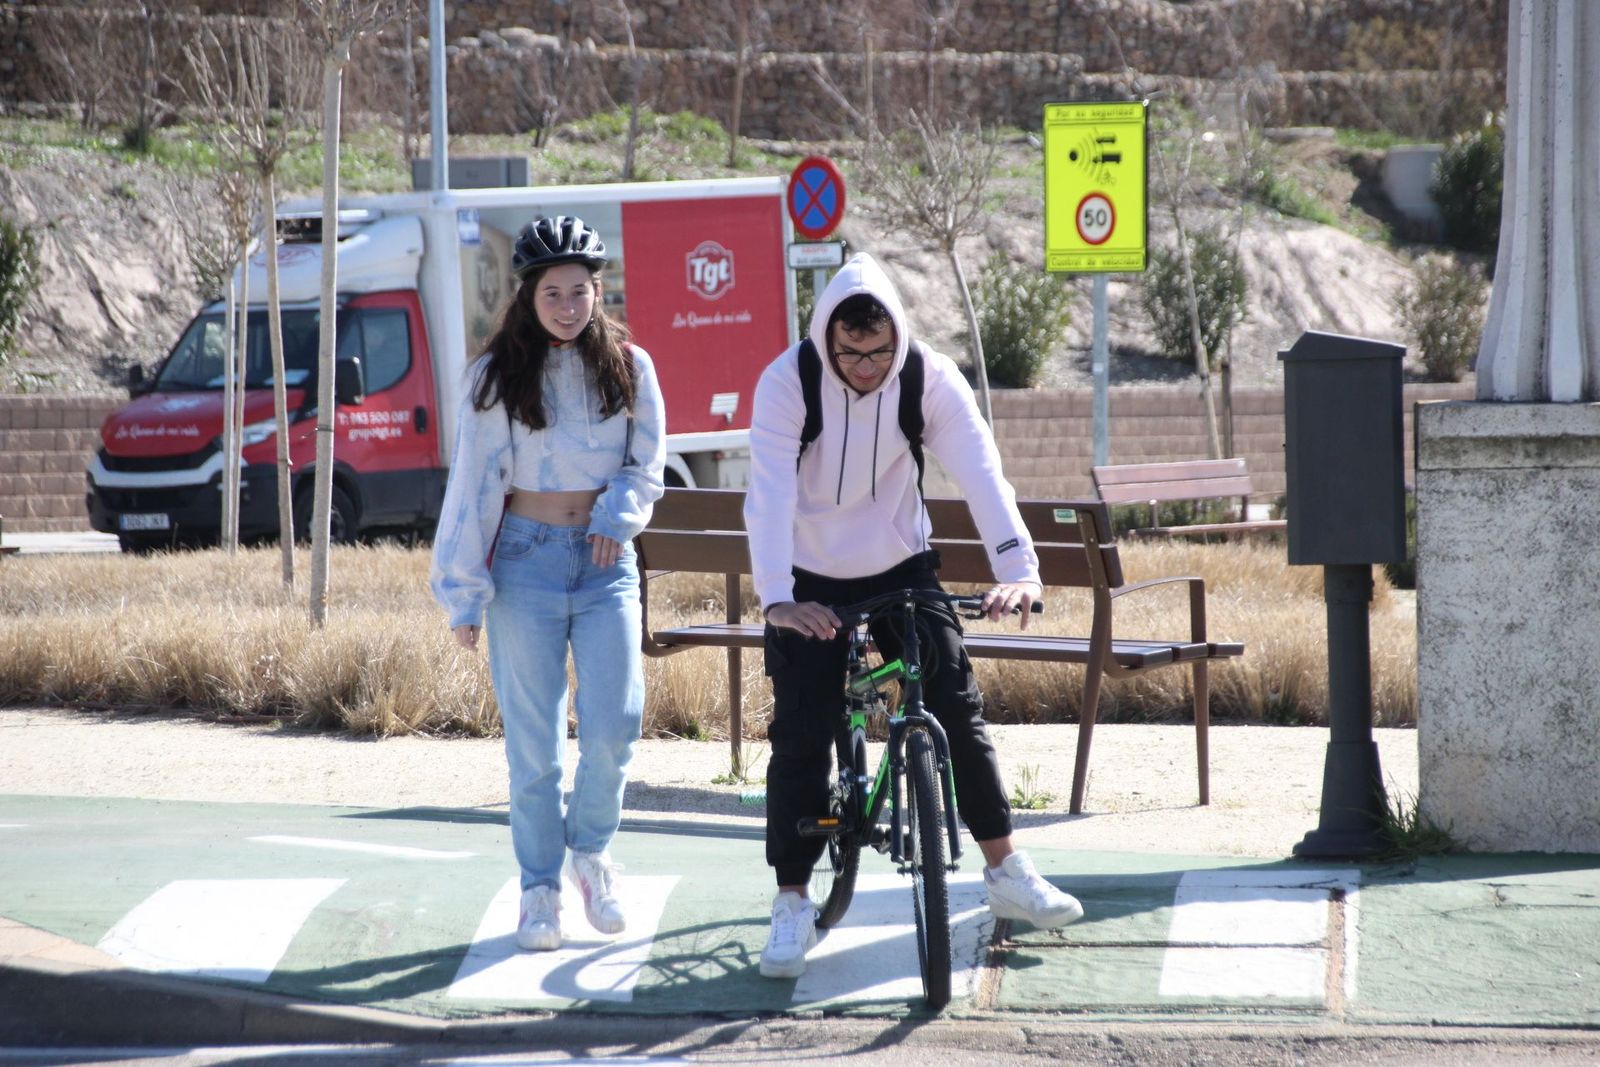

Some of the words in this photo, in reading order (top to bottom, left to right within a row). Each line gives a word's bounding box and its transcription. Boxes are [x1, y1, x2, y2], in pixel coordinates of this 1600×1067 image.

[1084, 208, 1107, 227] 50
[1087, 257, 1096, 266] de
[690, 256, 730, 291] Tgt
